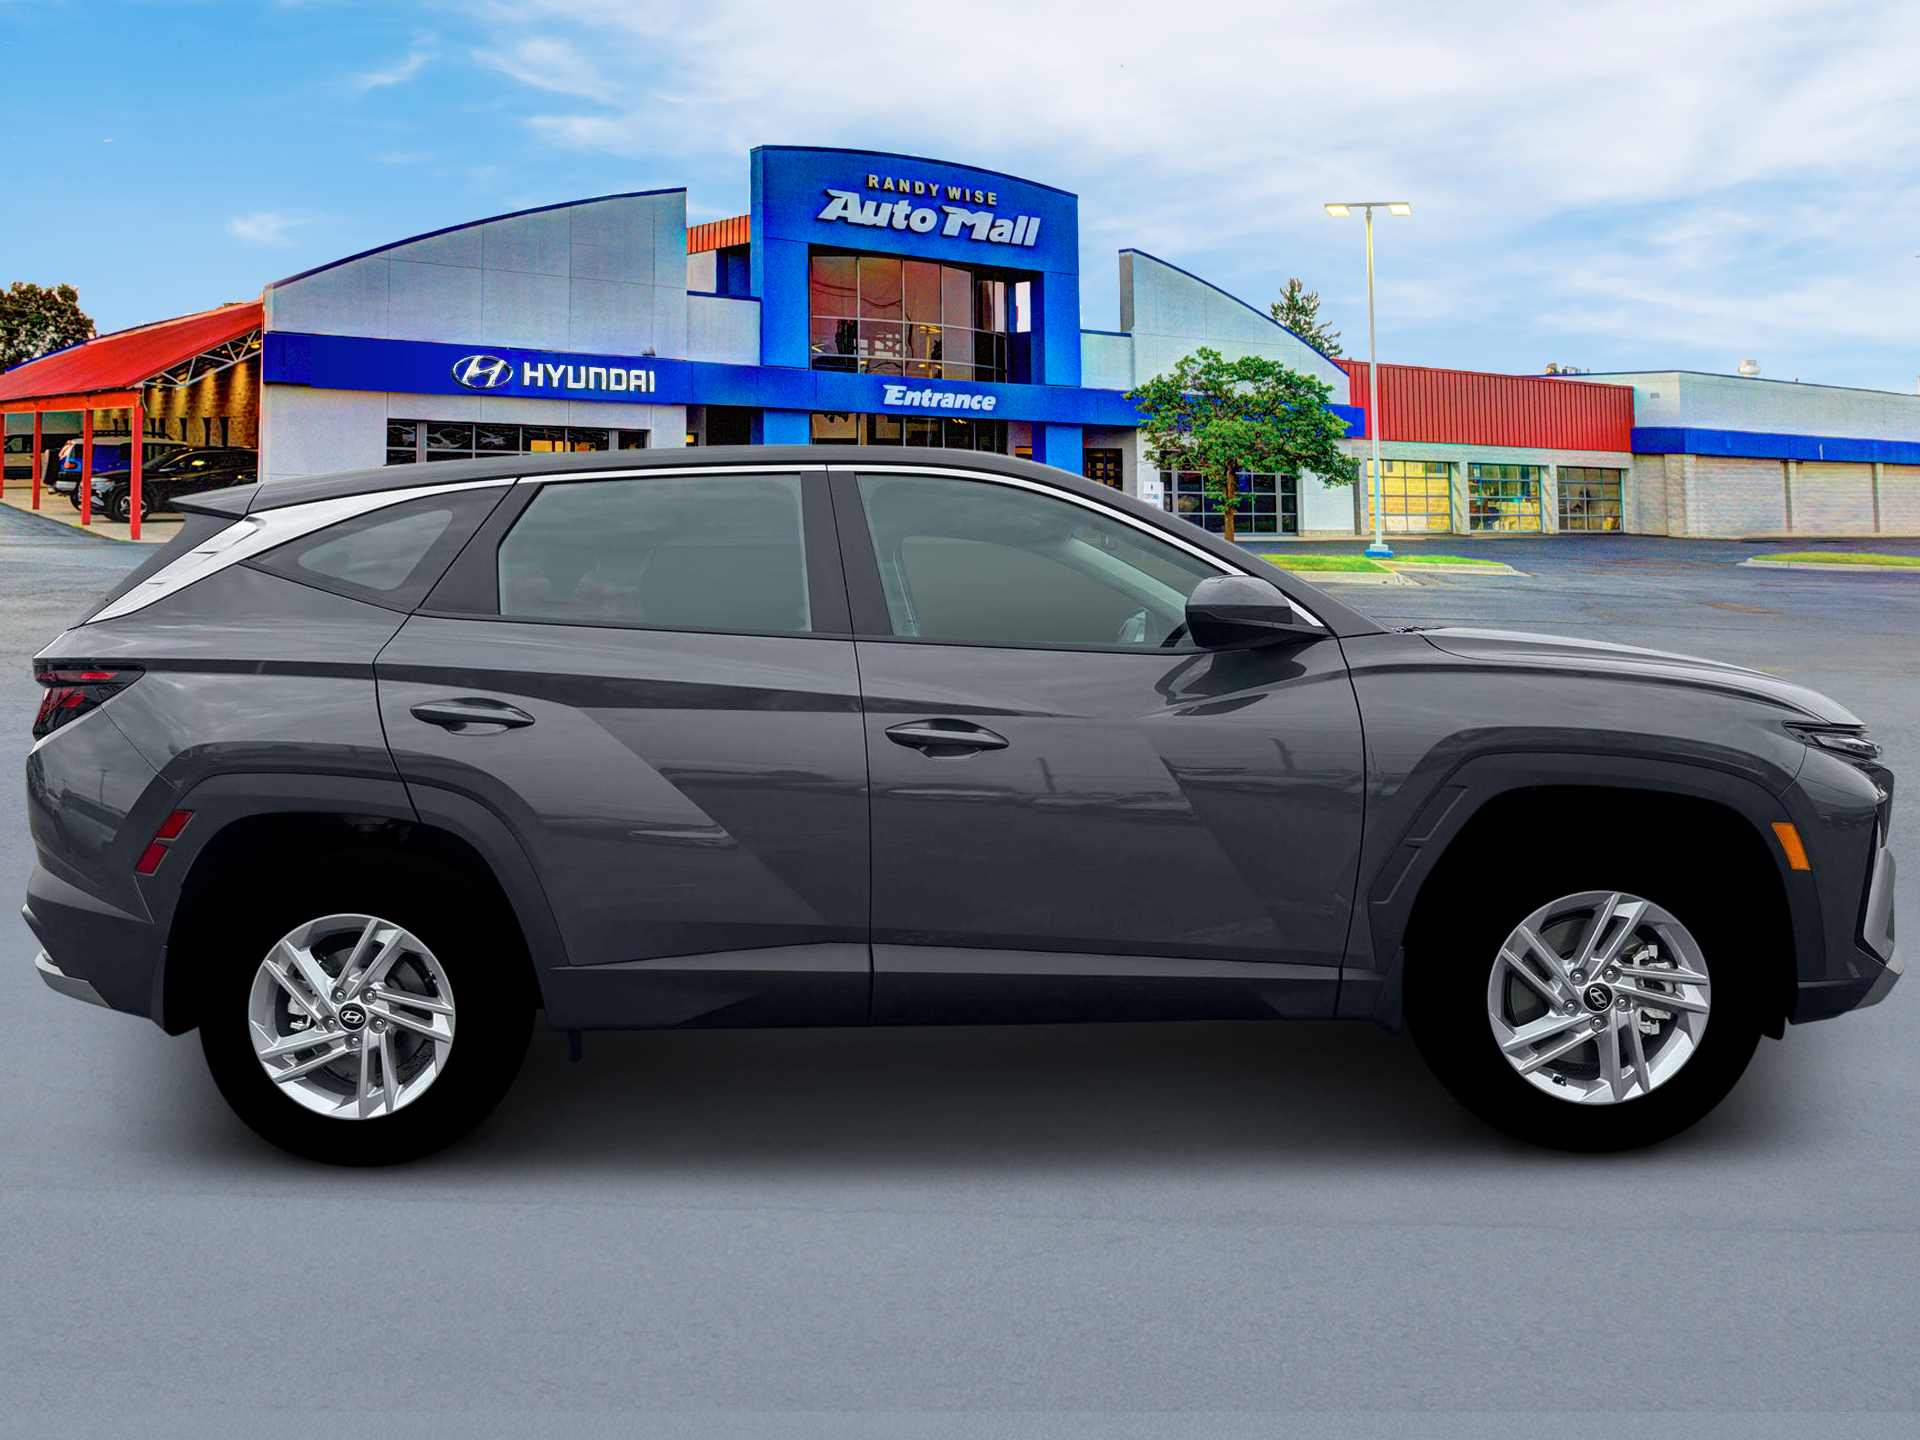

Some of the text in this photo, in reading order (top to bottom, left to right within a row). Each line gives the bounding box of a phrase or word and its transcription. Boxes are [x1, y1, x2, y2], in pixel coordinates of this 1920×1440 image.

[867, 174, 997, 205] RANDY WISE
[816, 188, 1041, 247] Auto Mall
[522, 362, 655, 392] HYUNDAI
[882, 384, 996, 411] Entrance
